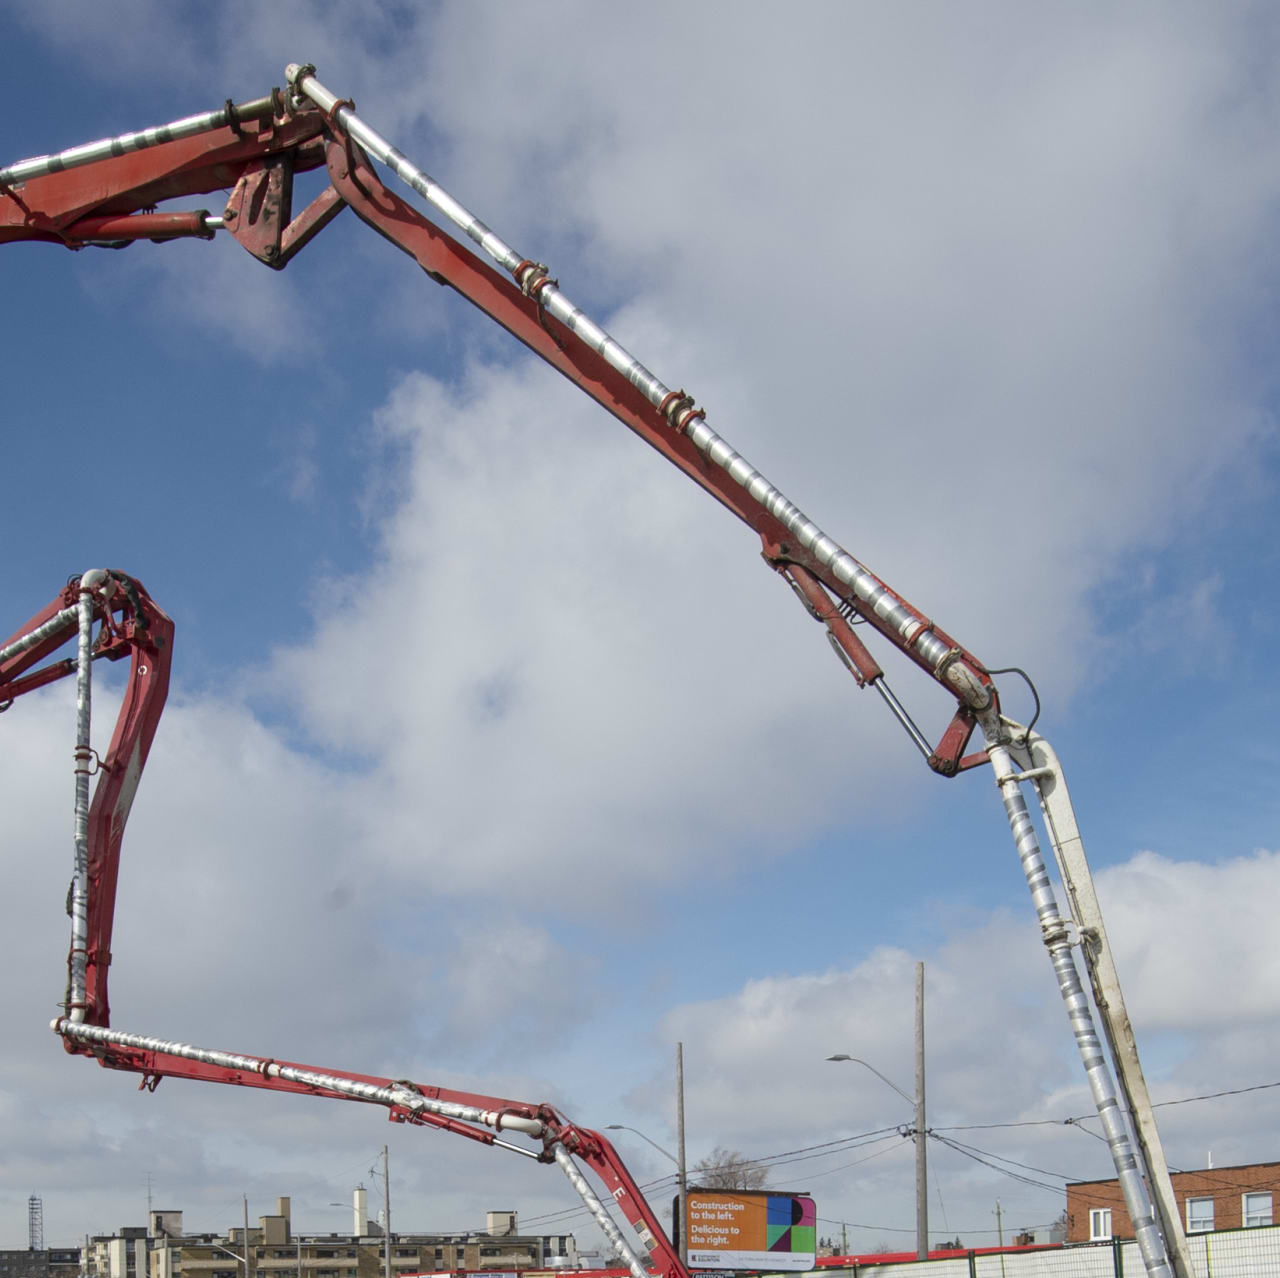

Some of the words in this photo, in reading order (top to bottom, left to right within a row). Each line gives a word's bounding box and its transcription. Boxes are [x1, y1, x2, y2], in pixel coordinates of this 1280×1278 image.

[690, 1200, 745, 1211] Construction
[690, 1211, 699, 1219] to
[701, 1211, 715, 1220] the
[716, 1211, 735, 1220] left.
[691, 1225, 729, 1235] Delicious
[730, 1226, 740, 1235] to
[690, 1235, 705, 1244] the
[706, 1235, 730, 1246] right.
